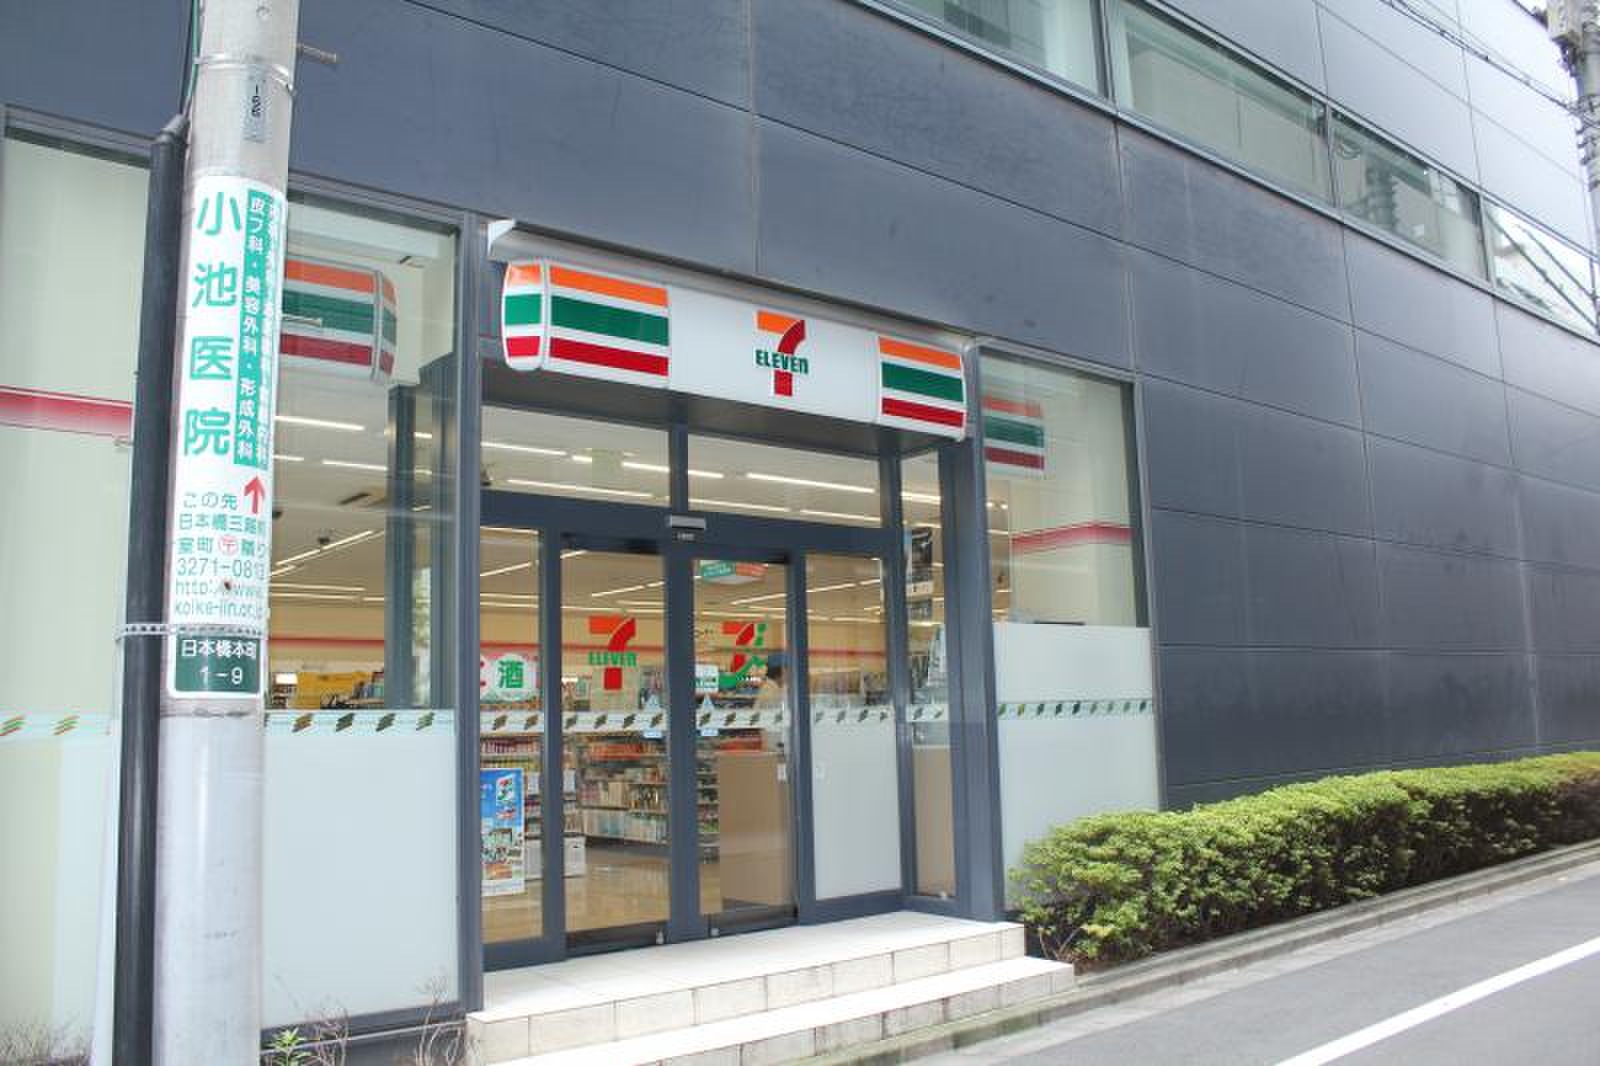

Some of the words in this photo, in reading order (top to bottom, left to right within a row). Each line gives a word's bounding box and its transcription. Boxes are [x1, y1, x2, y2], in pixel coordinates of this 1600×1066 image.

[184, 191, 241, 456] 小池医院
[757, 311, 805, 396] 7
[183, 491, 238, 511] この先
[494, 657, 523, 688] 酒
